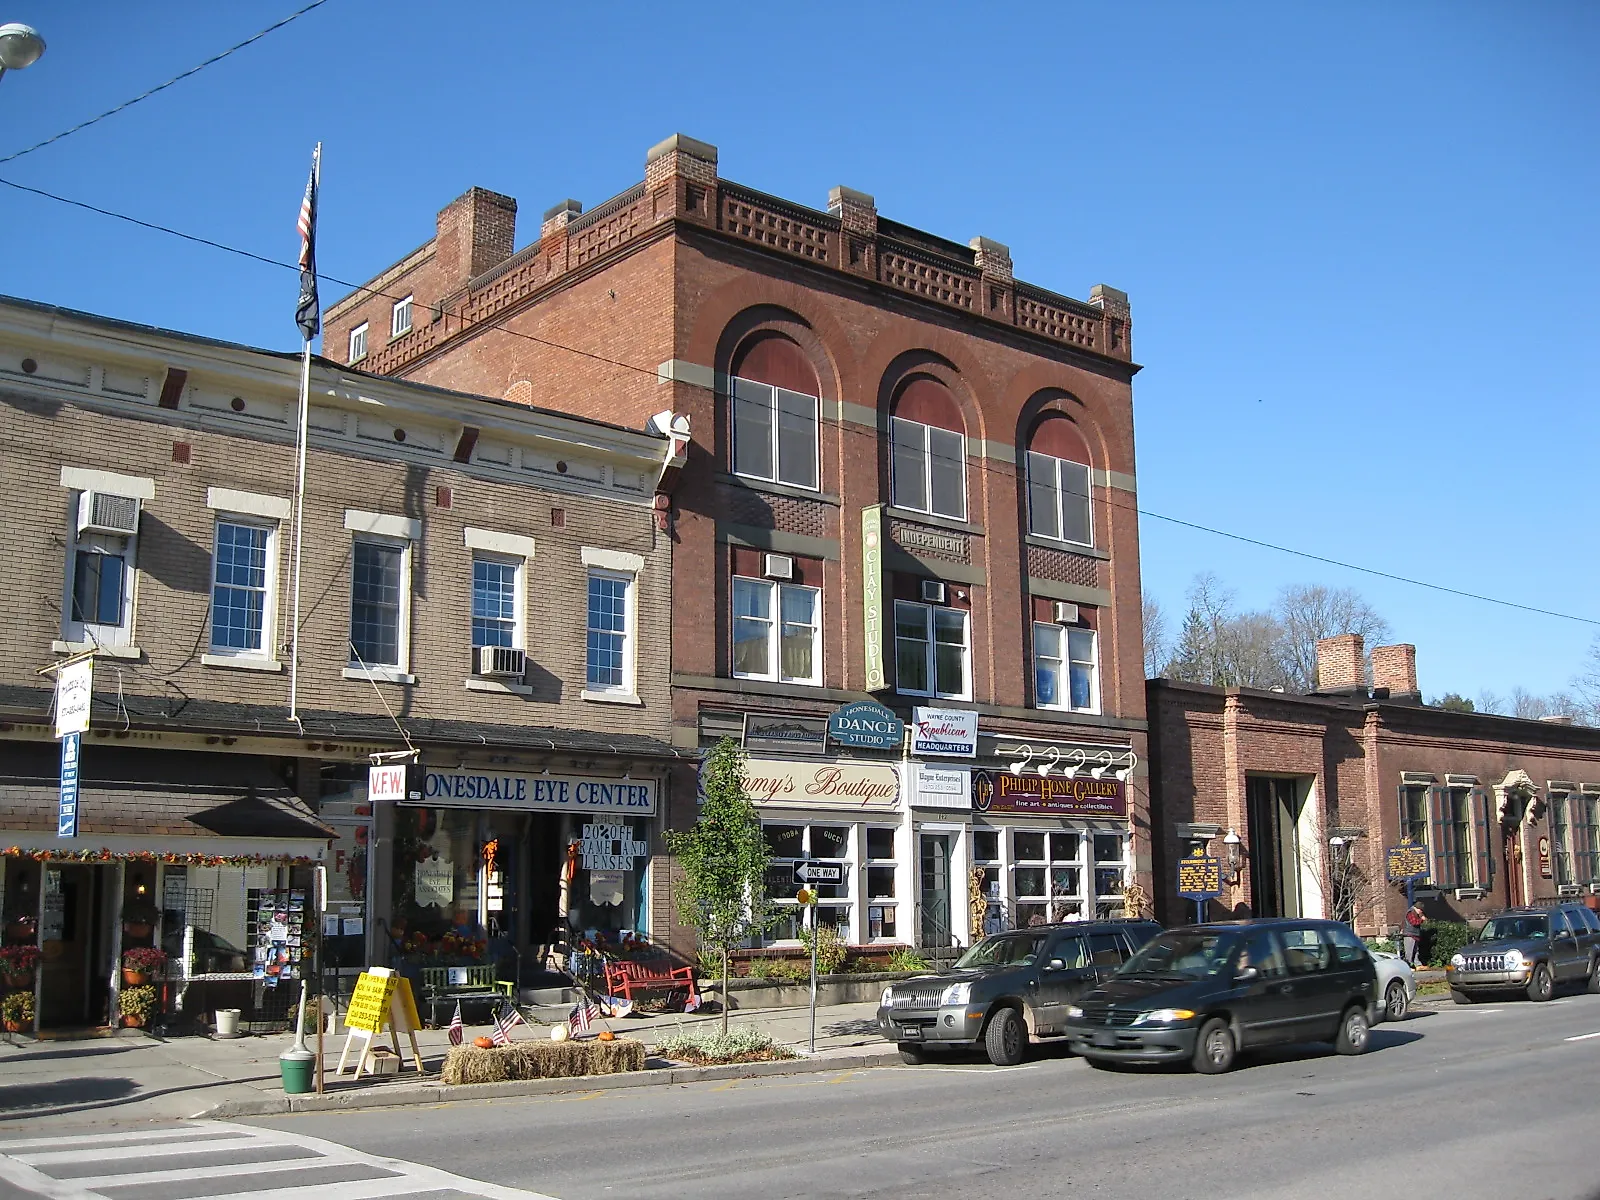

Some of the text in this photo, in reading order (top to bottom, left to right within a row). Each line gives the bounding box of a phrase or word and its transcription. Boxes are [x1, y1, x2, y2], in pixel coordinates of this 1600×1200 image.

[900, 528, 963, 554] INDEPENDENT
[866, 549, 878, 600] CLAY
[867, 605, 881, 682] STUDIO
[845, 705, 890, 721] HONESDALE
[927, 713, 965, 722] WAYNE COUNTY
[838, 718, 896, 734] DANCE
[917, 721, 968, 740] Republican
[849, 734, 884, 745] STUDIO
[917, 741, 970, 752] HEADQUARTERS
[371, 772, 403, 794] V.F.W.
[424, 774, 650, 807] ONESDALE EYE CENTER
[804, 766, 894, 807] Boutique
[1000, 776, 1038, 796] PHILIP
[1041, 779, 1072, 800] HONE
[1074, 780, 1118, 802] GALLERY
[1047, 801, 1074, 810] antiques
[823, 830, 843, 844] GUCCI
[578, 840, 646, 856] RAME AND
[584, 855, 632, 870] LENSES
[807, 868, 837, 878] ONE WAY
